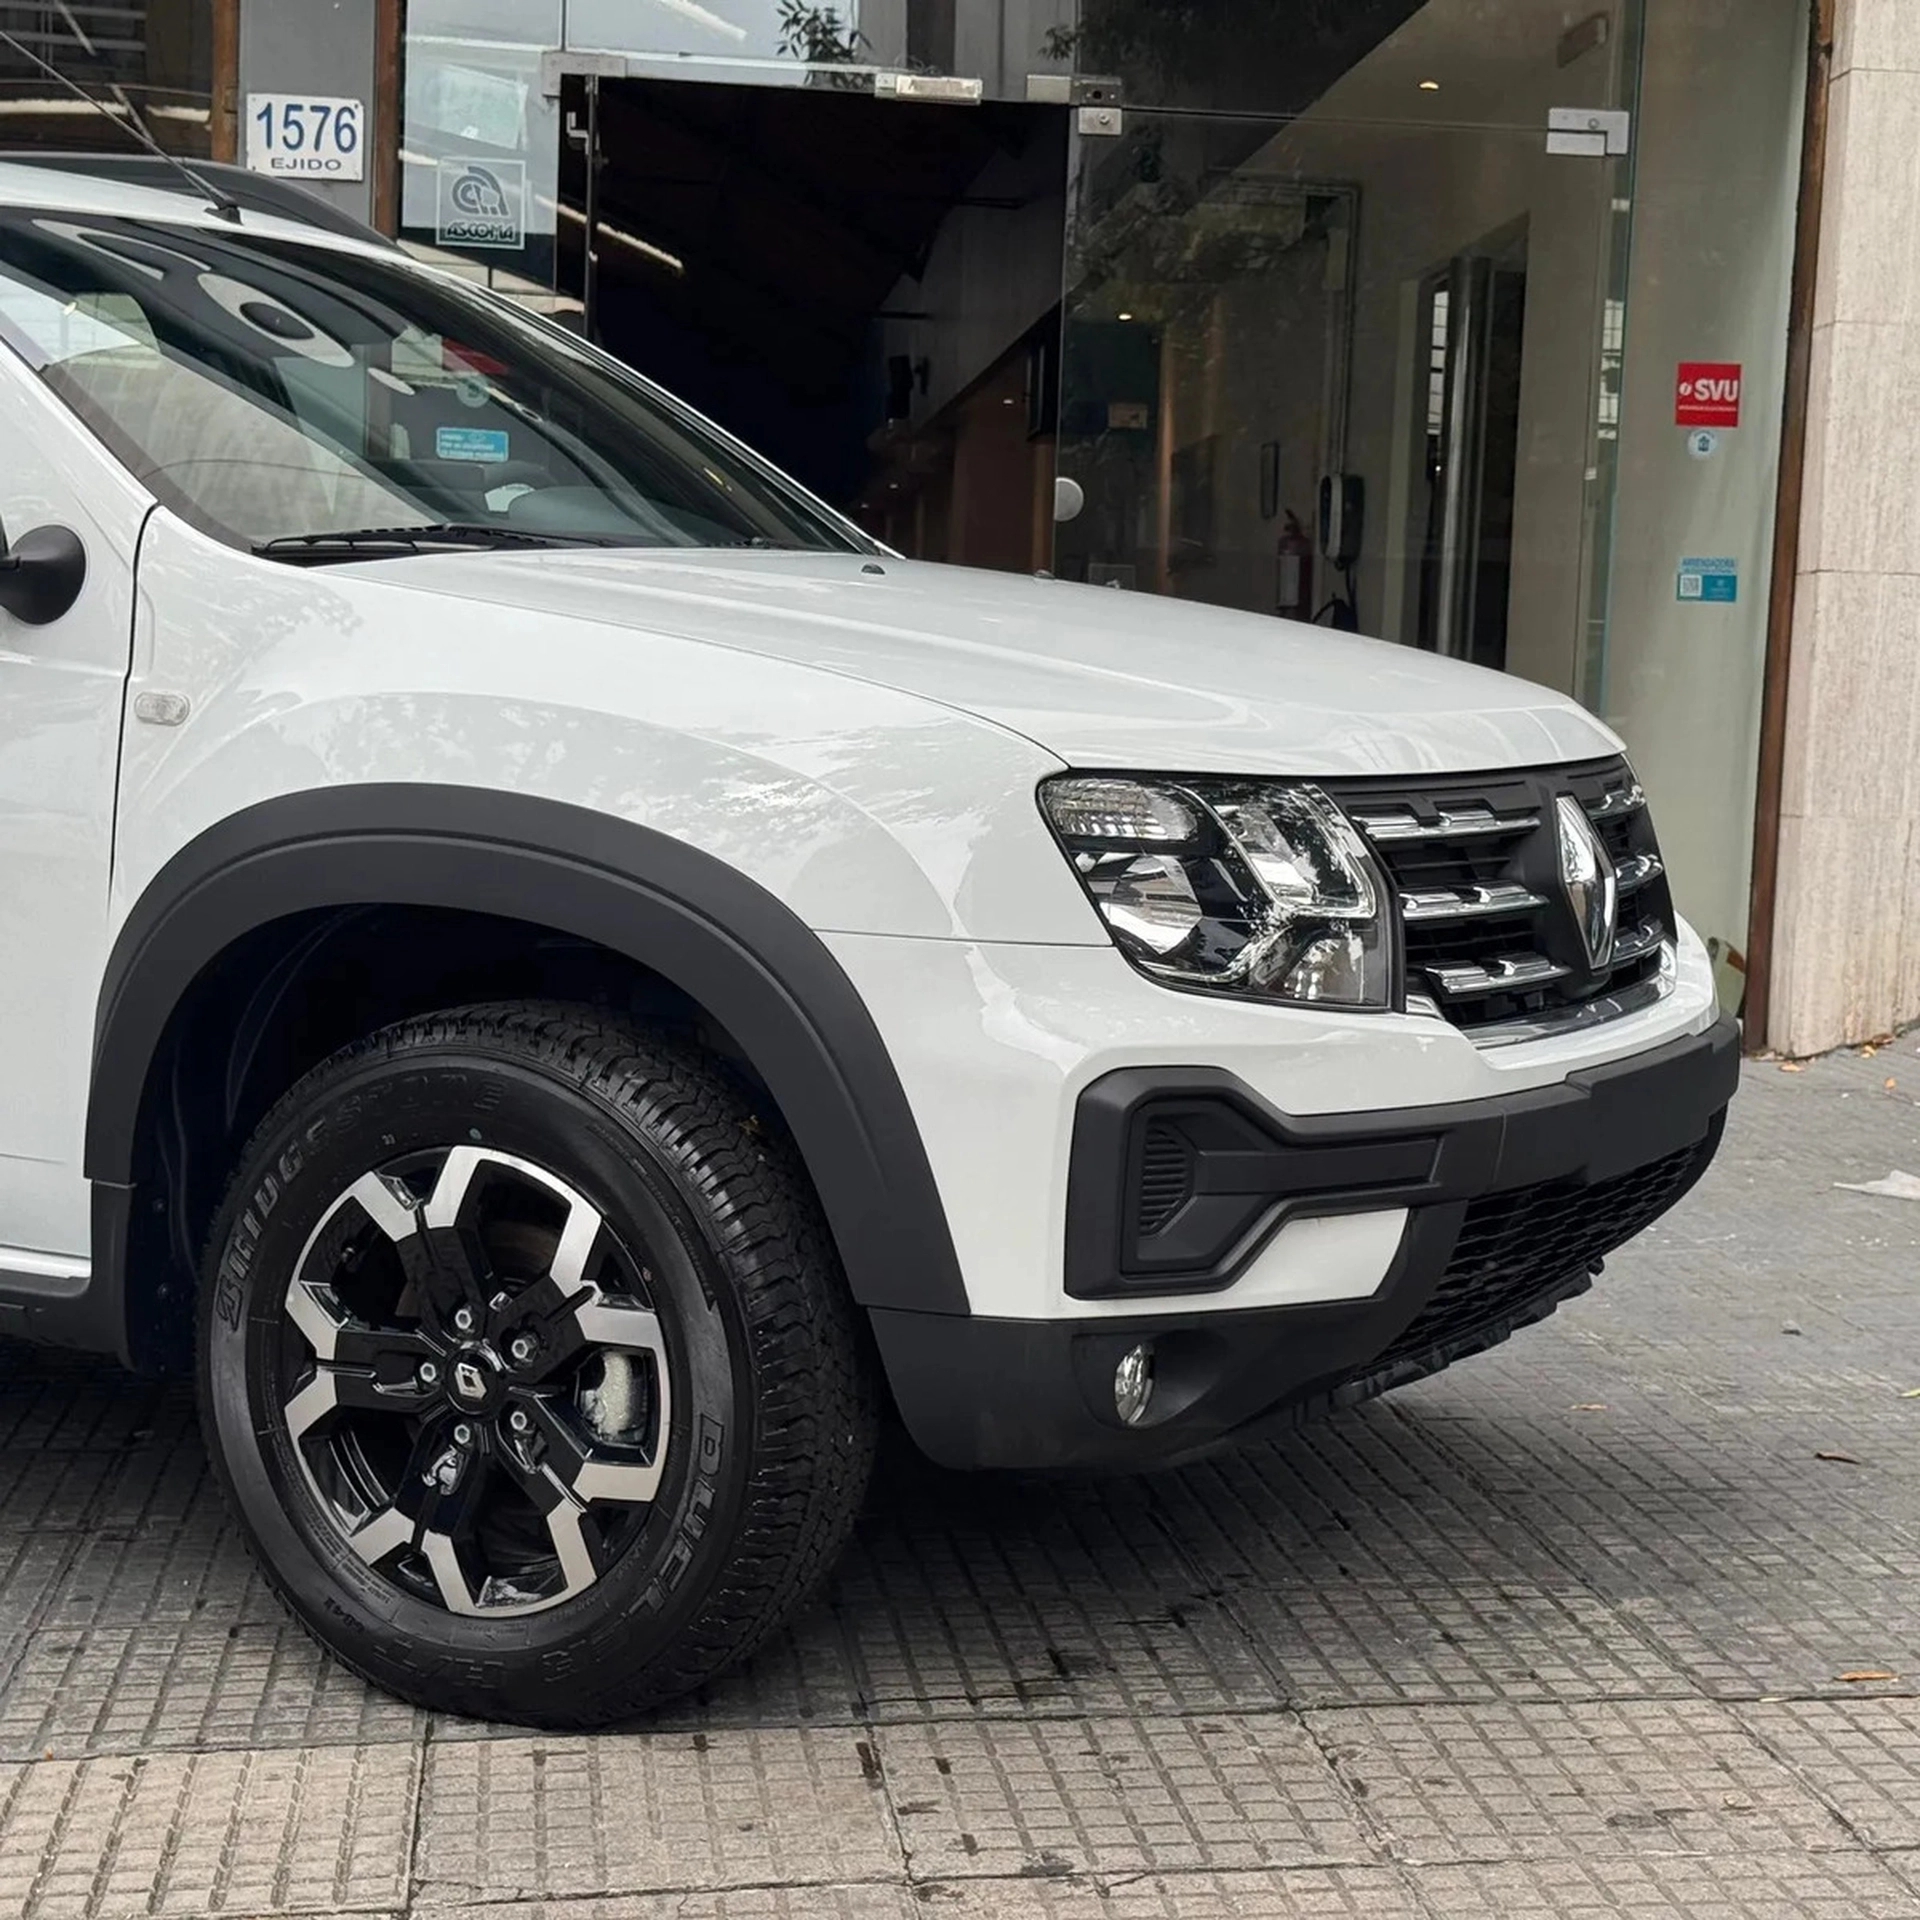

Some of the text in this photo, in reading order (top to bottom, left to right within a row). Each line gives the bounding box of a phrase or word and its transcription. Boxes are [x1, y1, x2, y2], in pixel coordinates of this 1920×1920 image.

[257, 102, 357, 153] 1576
[271, 157, 341, 171] EJIDO
[445, 221, 516, 241] ASCOMA
[1694, 378, 1739, 402] SVU
